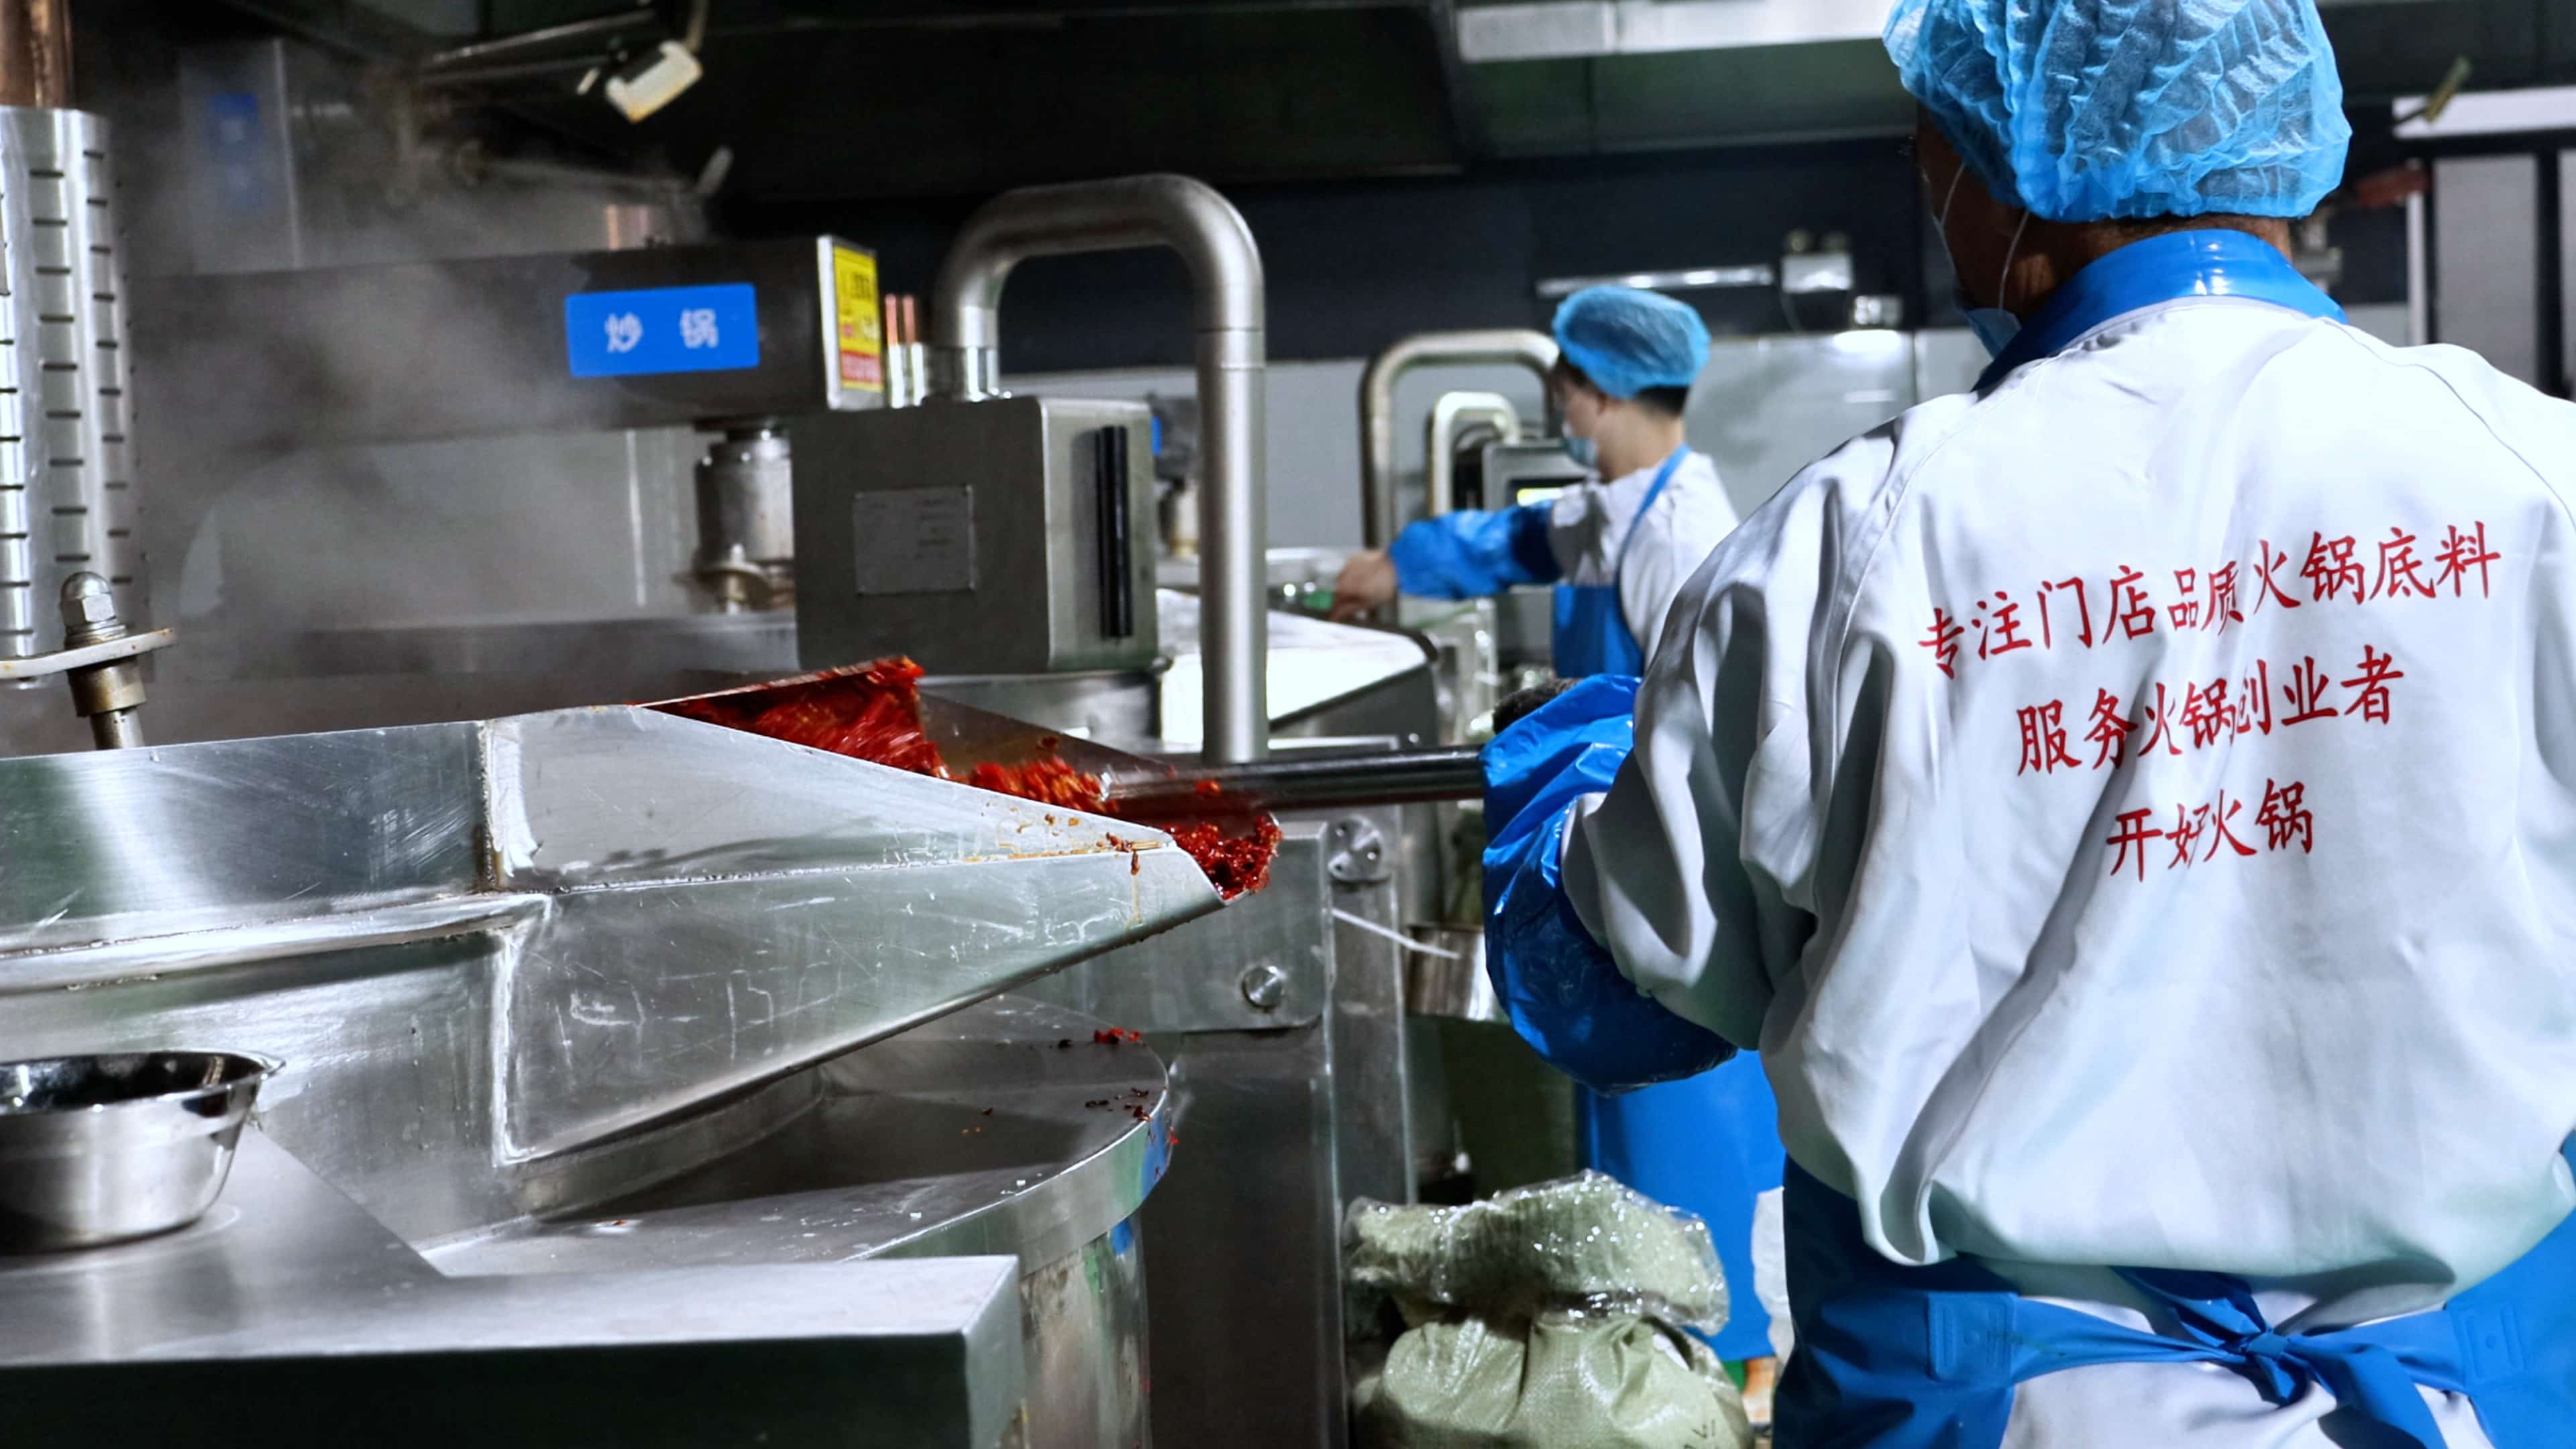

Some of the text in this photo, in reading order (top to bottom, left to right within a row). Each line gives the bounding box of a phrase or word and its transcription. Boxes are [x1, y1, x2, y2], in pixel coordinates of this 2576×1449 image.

[1919, 521, 2501, 679] 专注门店品质火锅底料
[2017, 645, 2404, 776] 服务火锅创业者
[2106, 778, 2312, 881] 开好火锅
